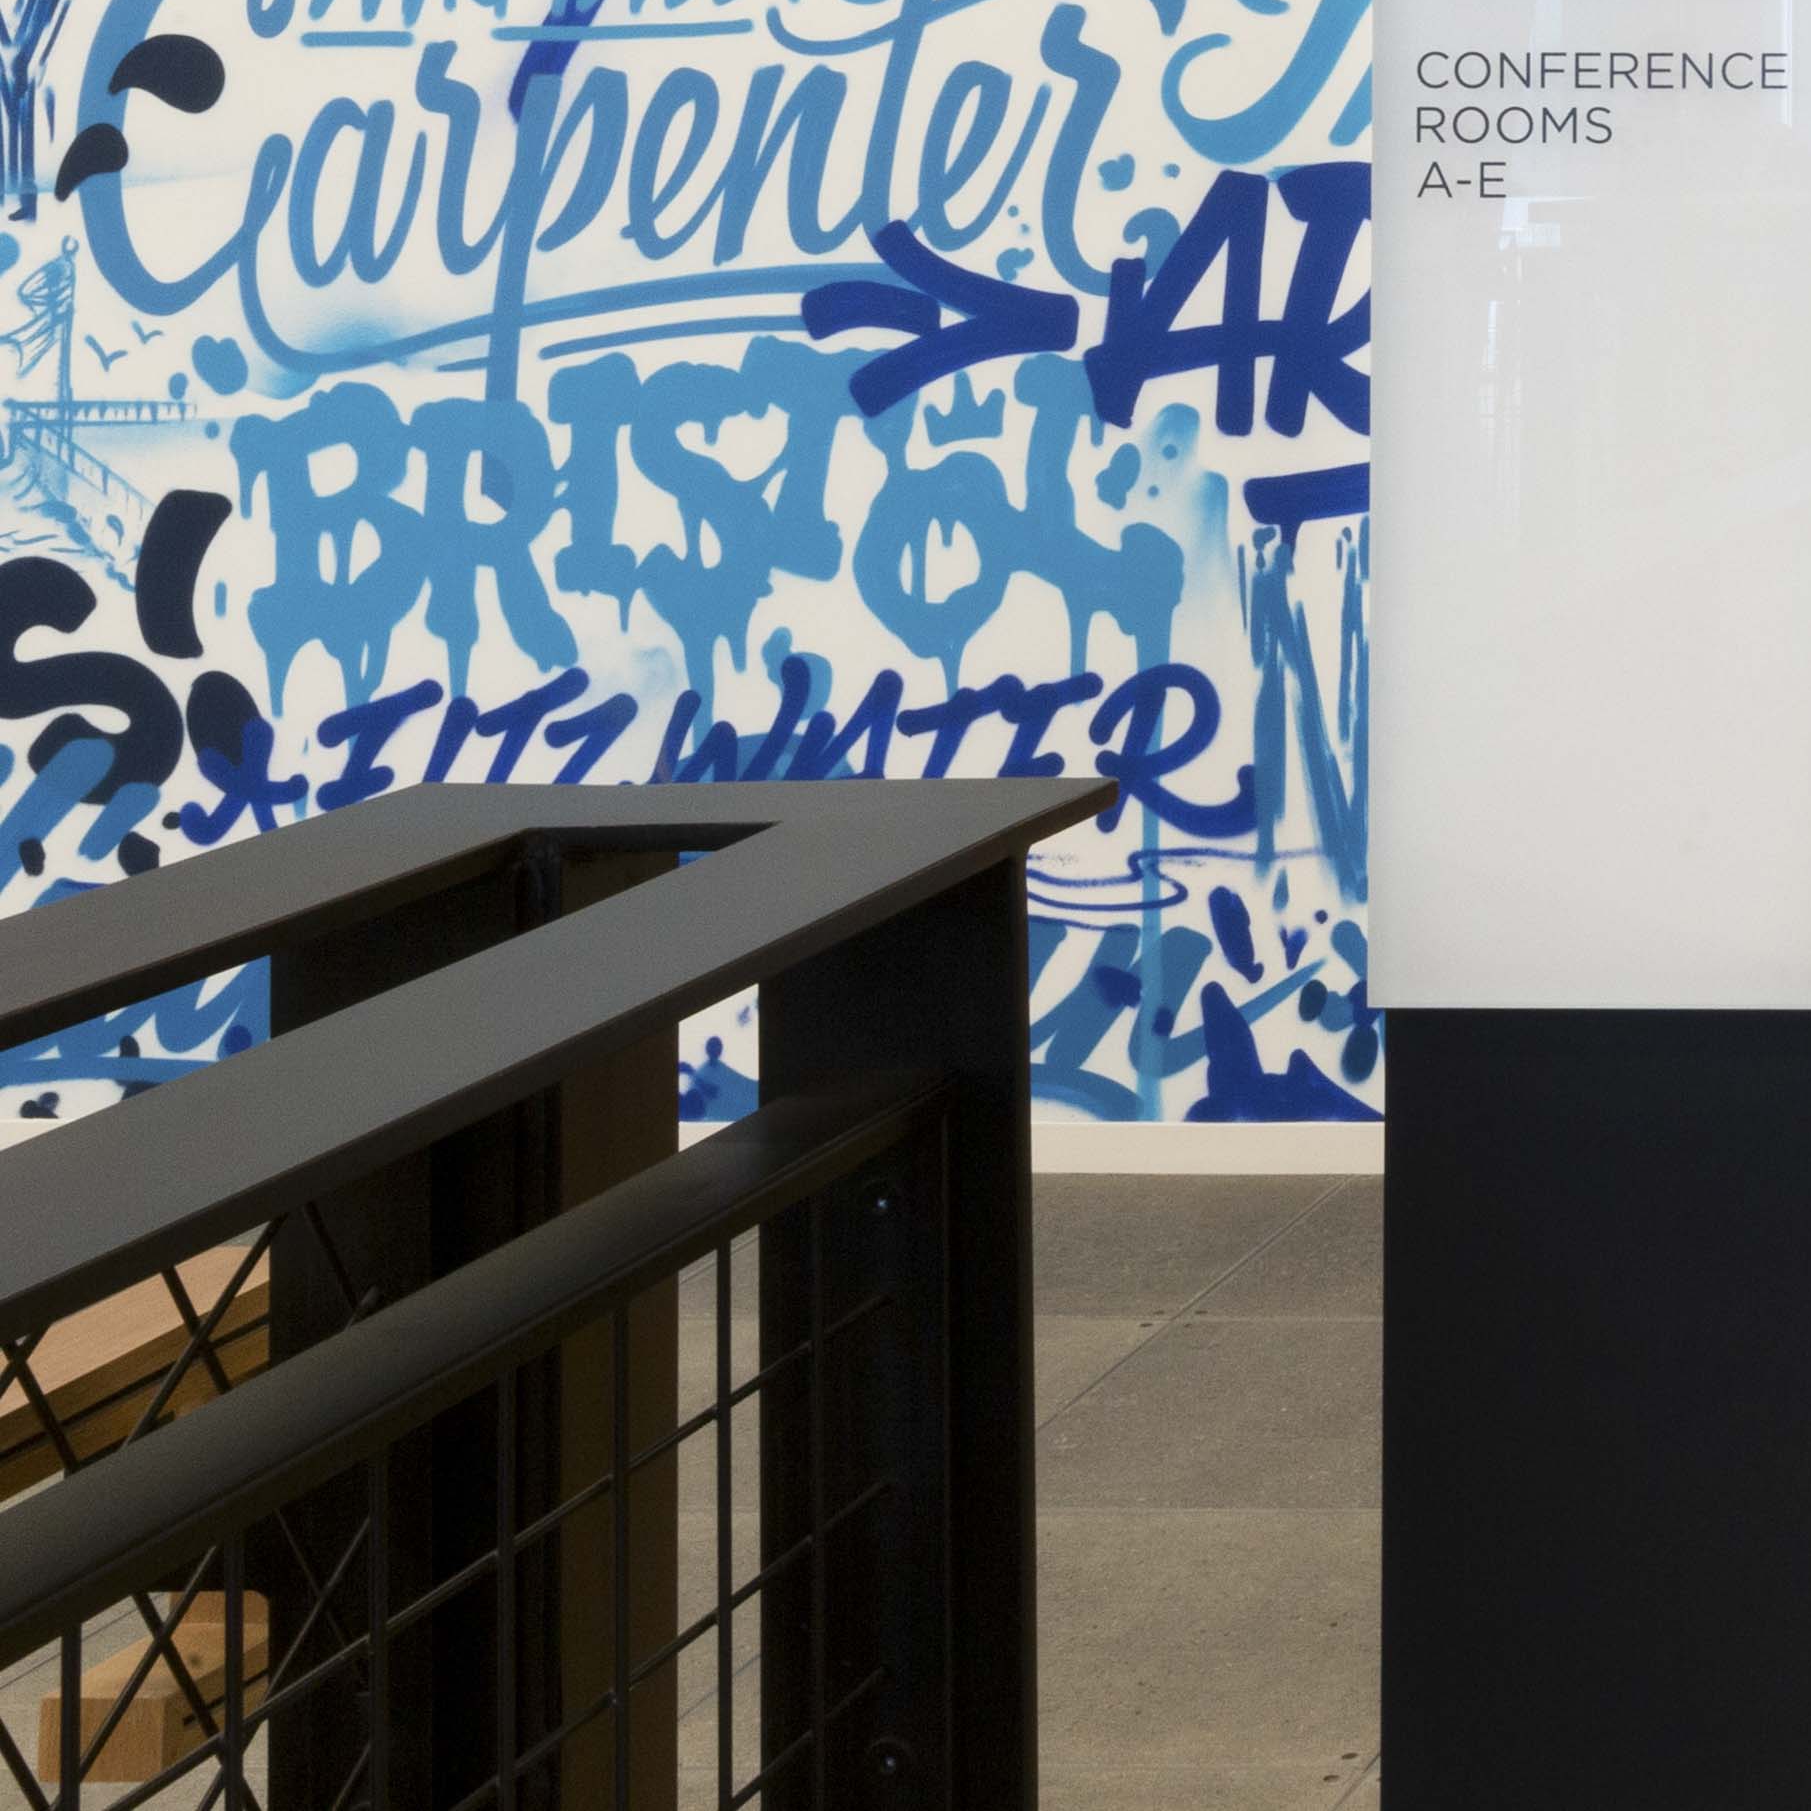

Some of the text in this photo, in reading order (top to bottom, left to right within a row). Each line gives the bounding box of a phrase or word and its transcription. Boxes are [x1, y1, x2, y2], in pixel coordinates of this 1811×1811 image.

[1416, 51, 1787, 90] CONFERENCE
[1416, 106, 1613, 144] ROOMS
[1417, 161, 1507, 199] A-E
[228, 336, 1184, 678] BRISTOL
